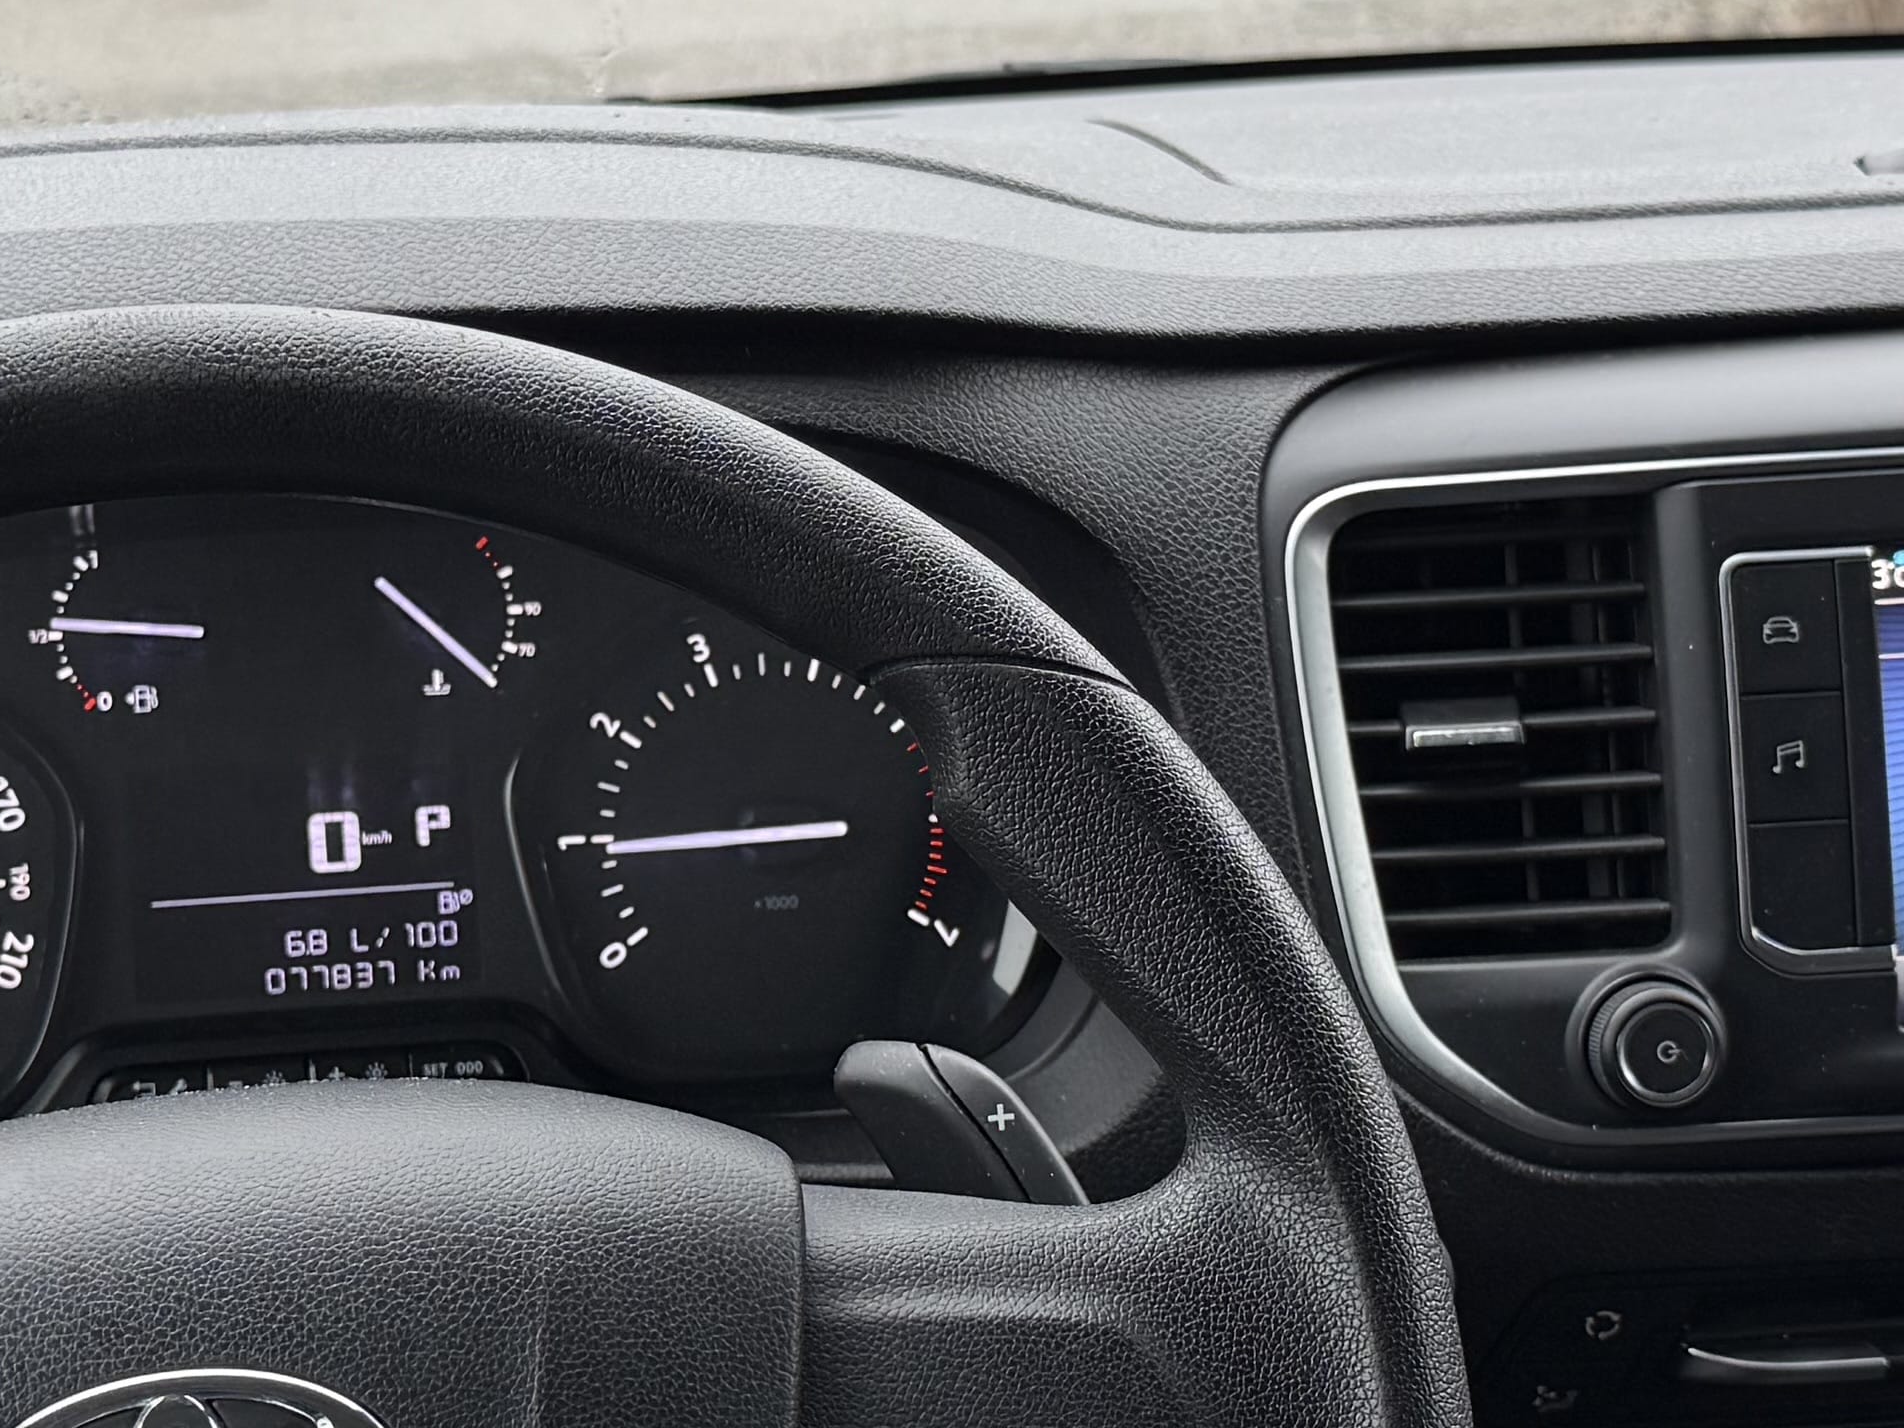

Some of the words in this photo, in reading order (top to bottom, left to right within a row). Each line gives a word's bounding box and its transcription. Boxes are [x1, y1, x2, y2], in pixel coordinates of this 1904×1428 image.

[524, 602, 541, 617] 90
[519, 643, 536, 658] 70
[686, 633, 711, 663] 3
[590, 712, 621, 739] 2
[414, 805, 451, 847] P
[307, 810, 362, 874] 0
[362, 828, 393, 847] km/h
[557, 834, 587, 851] 1
[9, 863, 31, 901] 190
[934, 919, 959, 947] 7
[599, 941, 628, 969] 0
[264, 960, 396, 996] 077837
